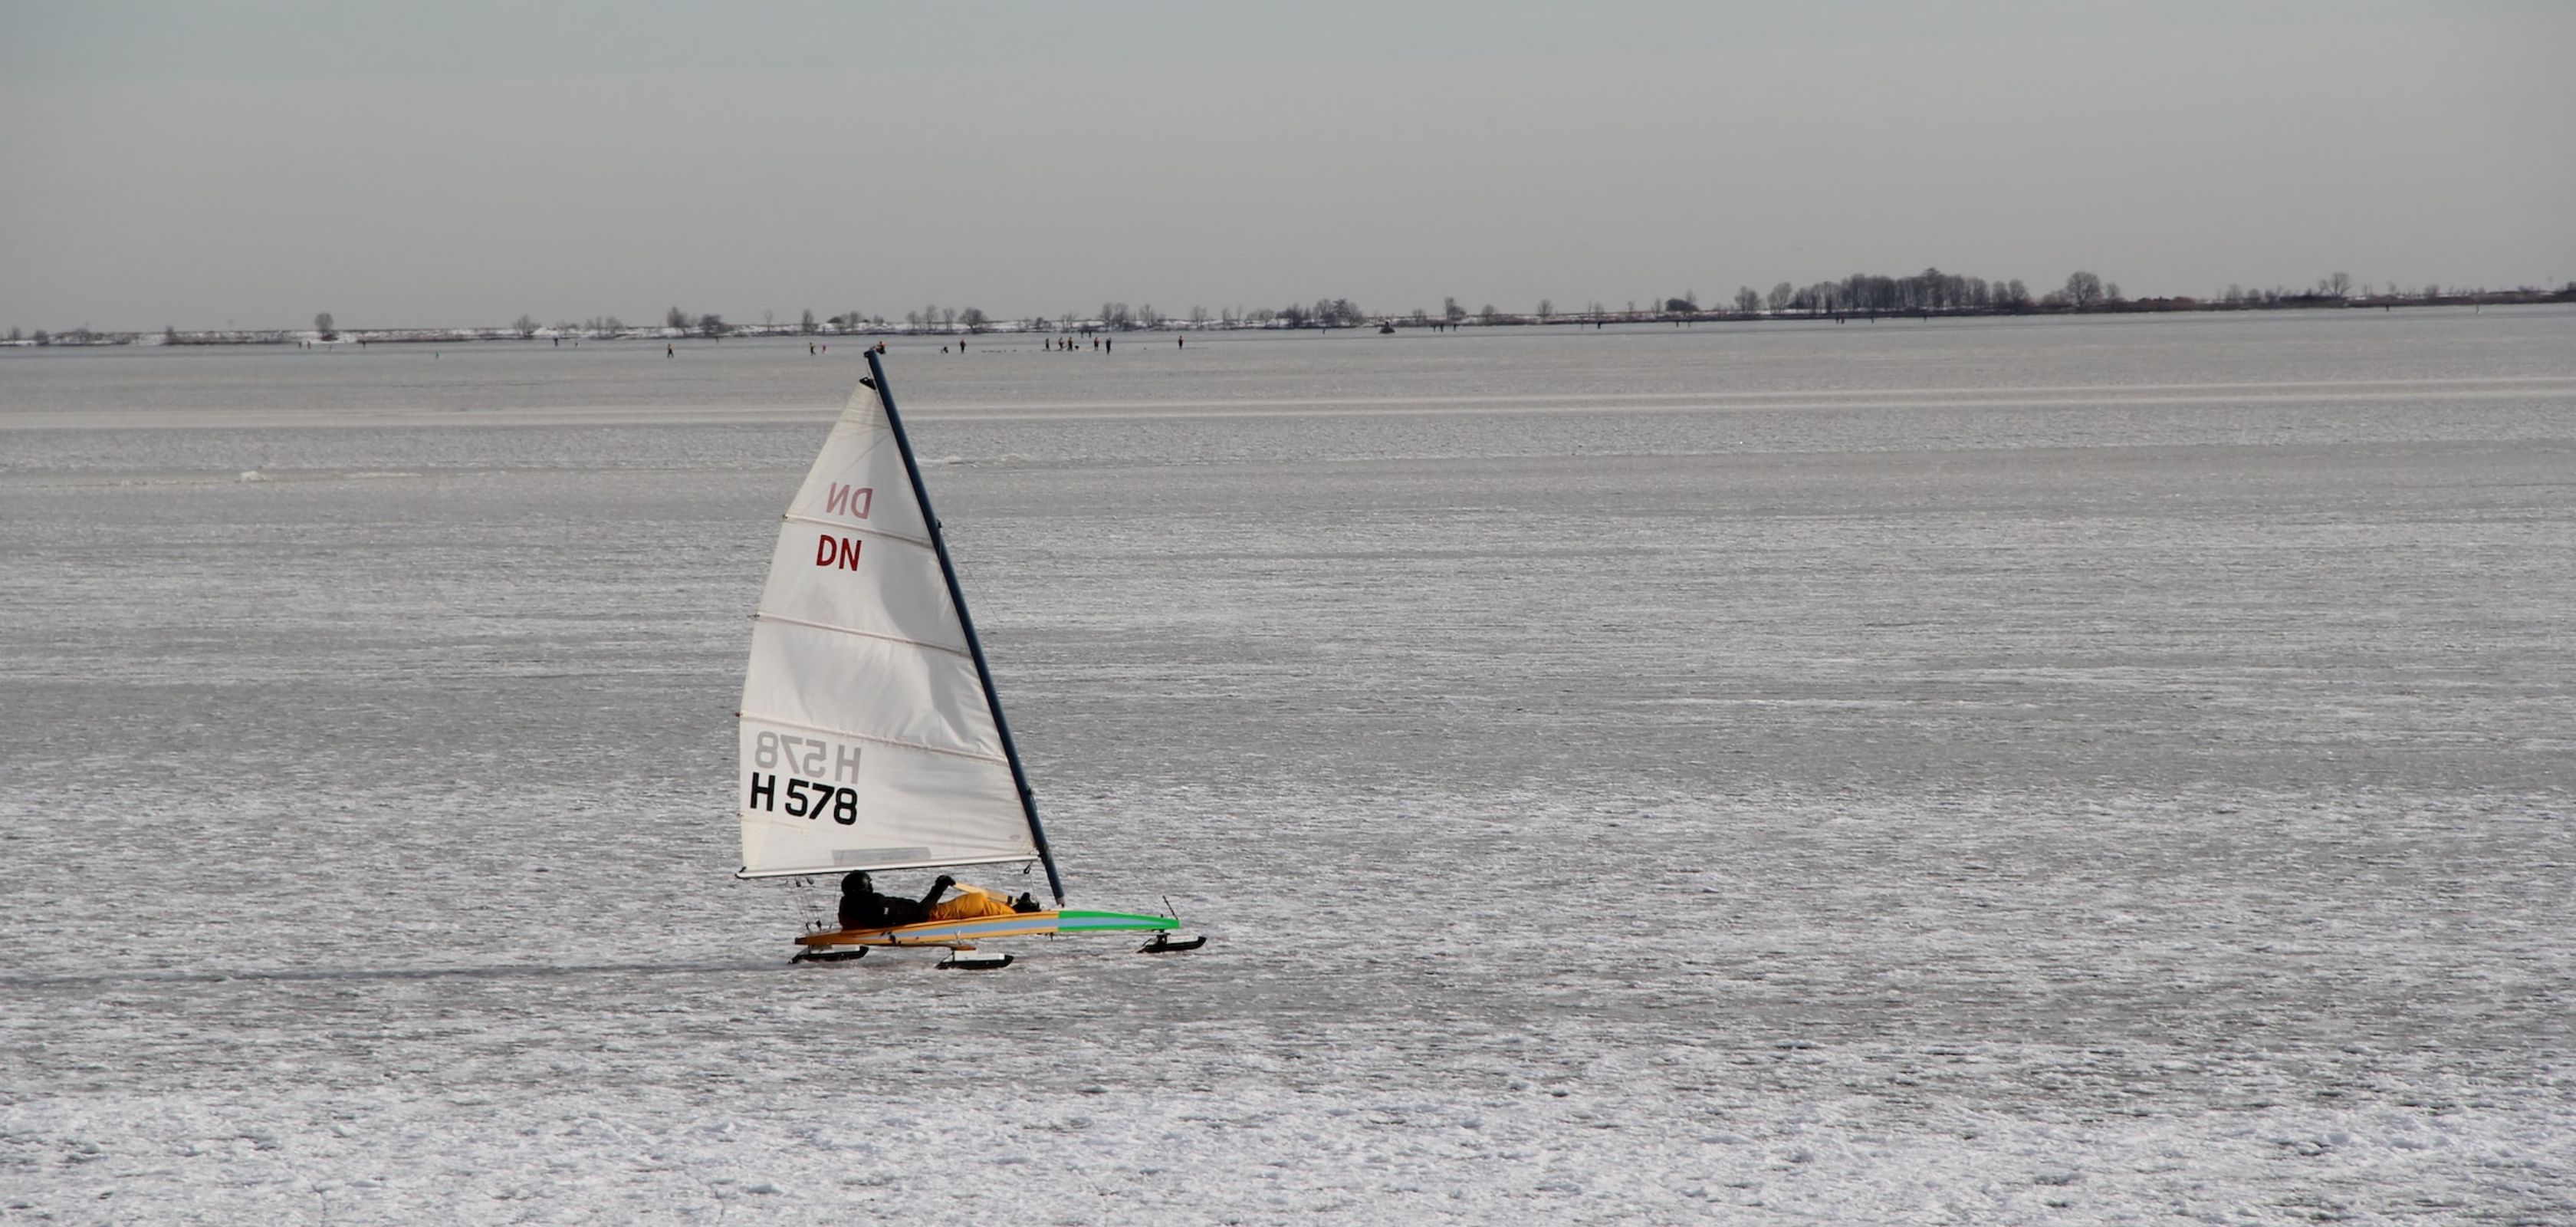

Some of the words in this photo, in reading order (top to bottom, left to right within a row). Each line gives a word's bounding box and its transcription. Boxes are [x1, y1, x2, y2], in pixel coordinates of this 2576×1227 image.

[816, 535, 862, 571] DN
[750, 771, 776, 812] H
[784, 778, 858, 826] 578
